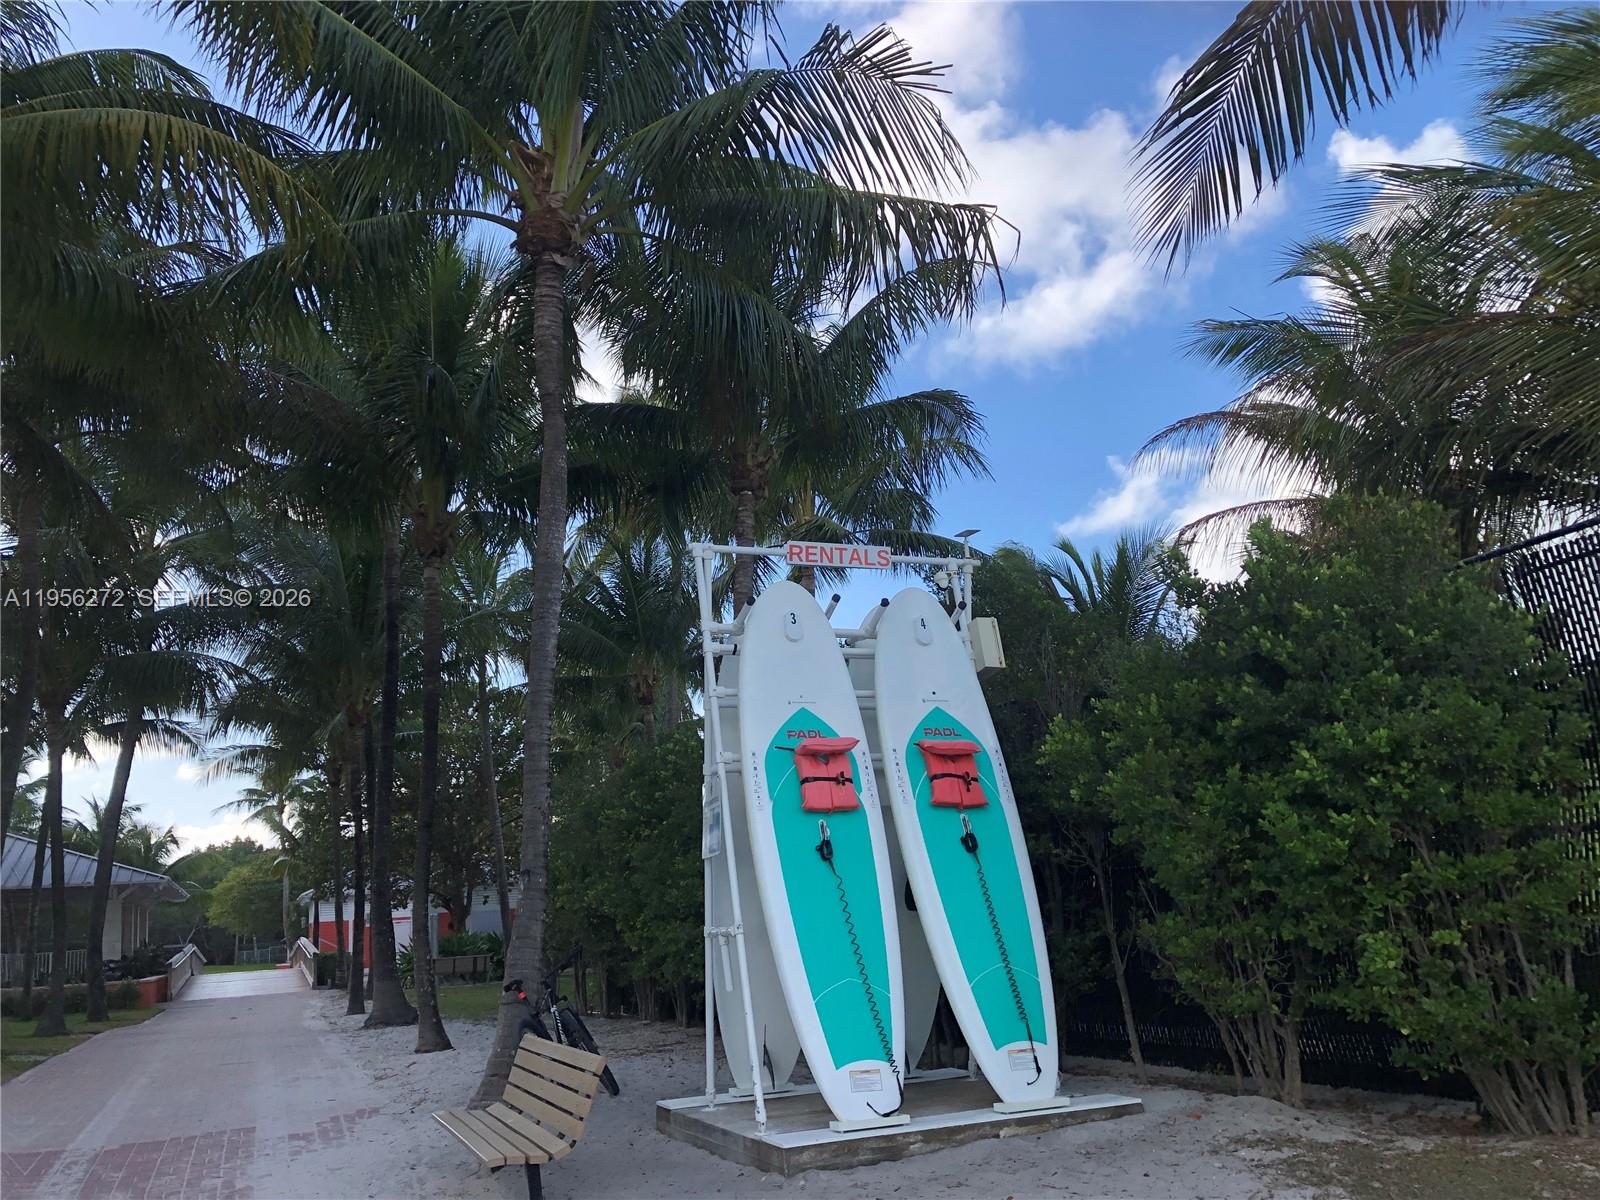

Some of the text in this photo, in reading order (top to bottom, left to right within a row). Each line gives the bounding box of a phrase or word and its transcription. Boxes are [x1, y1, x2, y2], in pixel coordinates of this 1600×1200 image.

[788, 544, 891, 567] RENTALS
[790, 612, 797, 625] 3
[920, 618, 927, 630] 4
[786, 729, 828, 739] PADL
[923, 727, 962, 737] PADL
